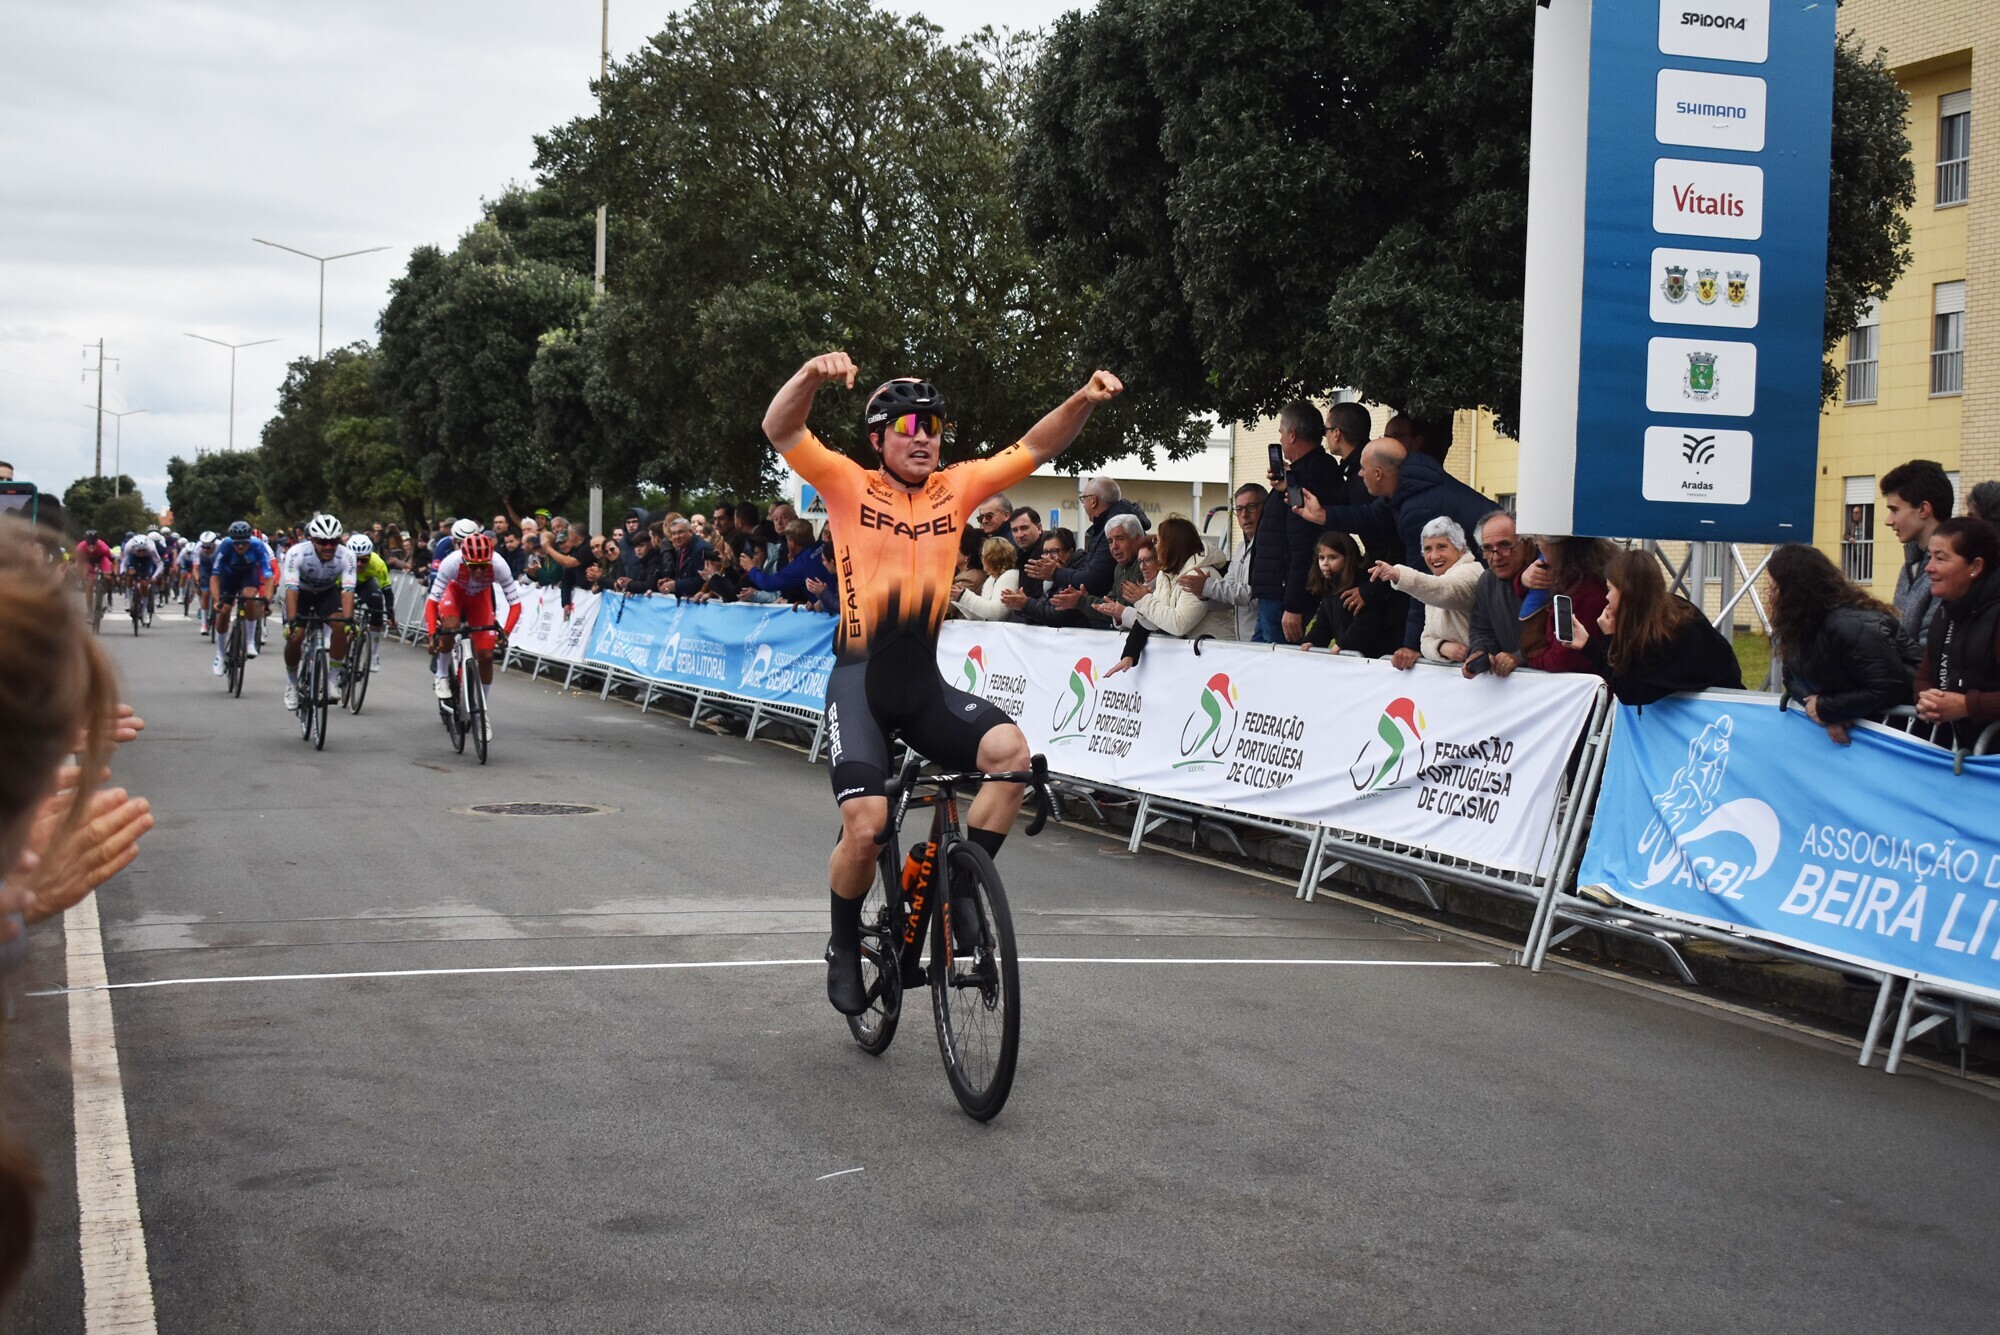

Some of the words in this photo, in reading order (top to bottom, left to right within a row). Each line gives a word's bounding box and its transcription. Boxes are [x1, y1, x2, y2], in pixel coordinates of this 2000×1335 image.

[1677, 101, 1746, 119] SHIMANO
[1672, 182, 1744, 217] Vitalis
[1681, 481, 1713, 490] Aradas
[860, 503, 957, 541] EFAPEL
[841, 545, 861, 638] EFAPEL
[677, 652, 695, 674] BEIRA
[696, 655, 726, 680] LITORAL
[988, 674, 1026, 698] FEDERAÇÃO
[1100, 690, 1142, 717] FEDERAÇÃO
[828, 702, 843, 767] EFAPEL
[1094, 713, 1142, 739] PORTUGUESA
[1242, 711, 1304, 744] FEDERAÇÃO
[1088, 734, 1100, 752] DE
[1235, 738, 1303, 770] PORTUGUESA
[1226, 762, 1245, 783] DE
[1243, 765, 1293, 789] CICLISMO
[1417, 786, 1438, 811] DE
[1800, 823, 1979, 883] ASSOCIAÇÃO
[1671, 850, 1752, 900] ACBL
[904, 841, 937, 943] CANYON
[1778, 863, 1927, 942] BEIRA
